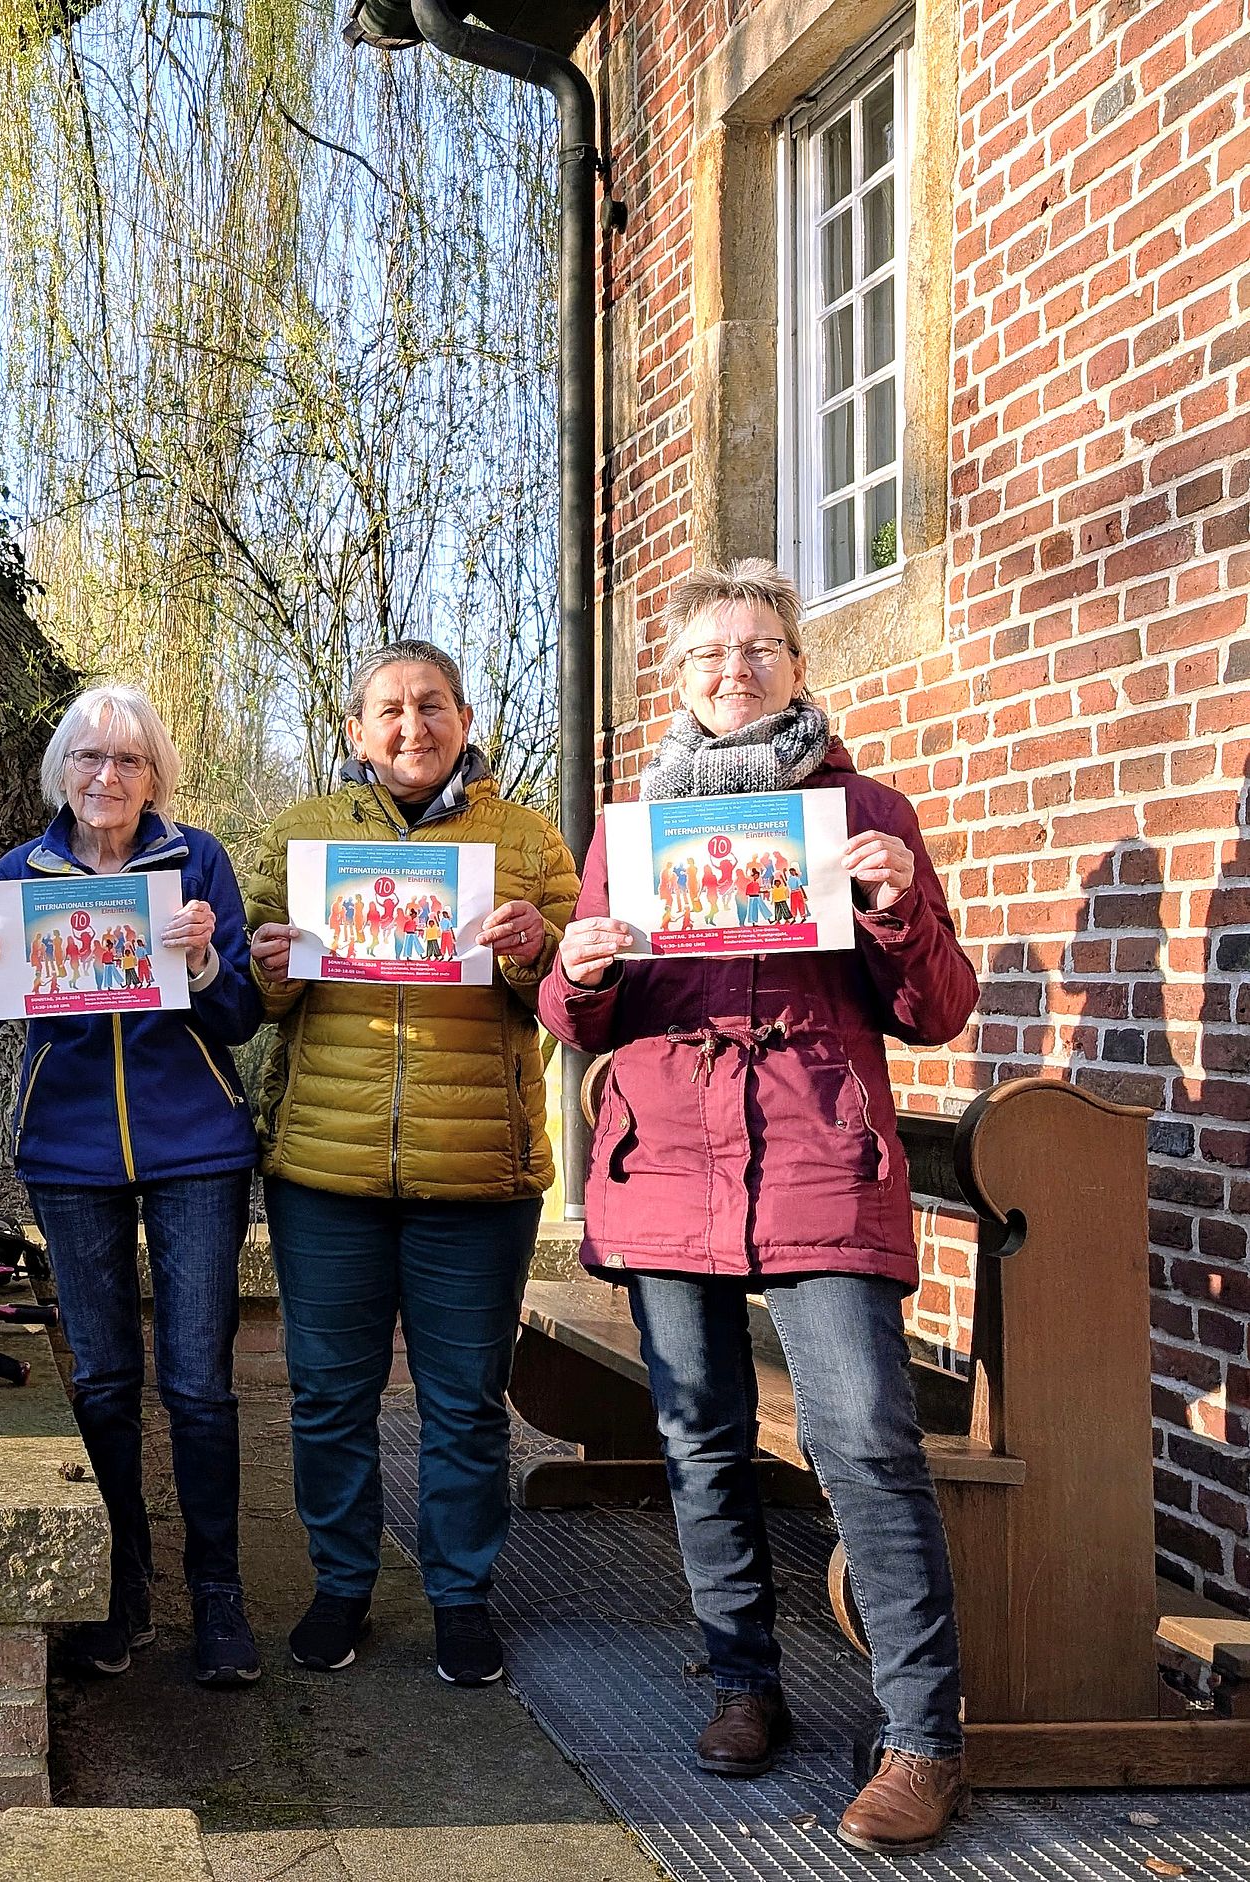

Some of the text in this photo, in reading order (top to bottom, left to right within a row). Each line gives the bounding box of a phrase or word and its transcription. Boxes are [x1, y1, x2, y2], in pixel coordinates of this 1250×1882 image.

[665, 821, 788, 836] INTERNATIONALES FRAUENFEST
[712, 840, 727, 854] 10
[378, 880, 391, 893] 10
[35, 899, 136, 911] INTERNATIONALES FRAUENFEST
[74, 914, 87, 927] 10
